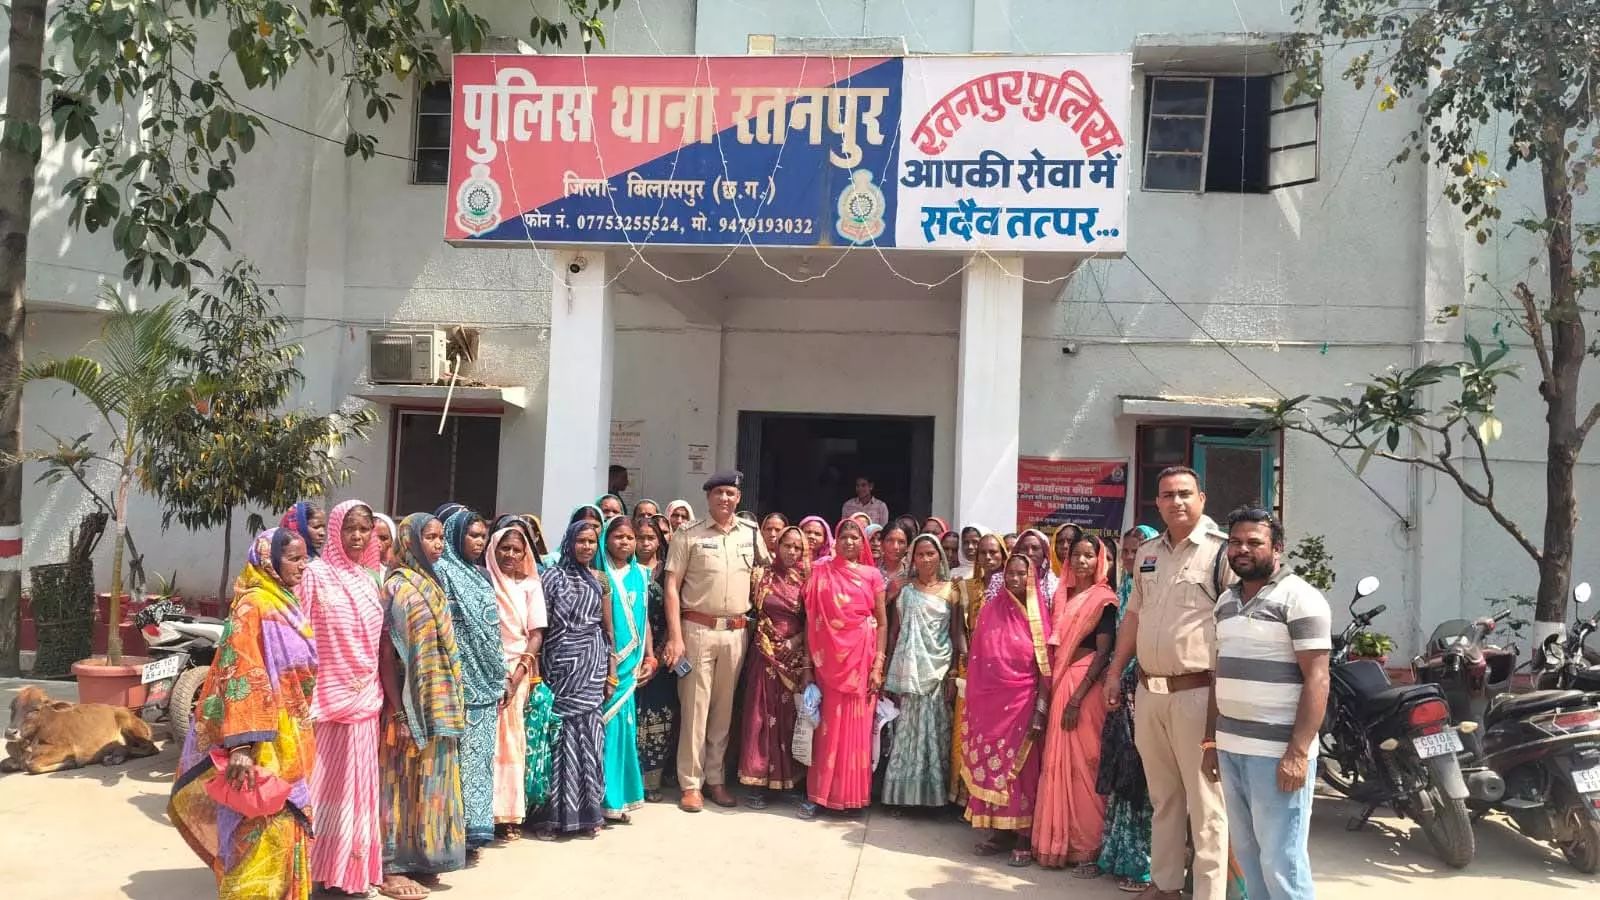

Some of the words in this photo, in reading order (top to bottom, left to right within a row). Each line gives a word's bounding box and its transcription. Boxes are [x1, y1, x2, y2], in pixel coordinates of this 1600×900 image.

[462, 68, 599, 164] पुलिस
[610, 84, 720, 145] थाना
[730, 87, 890, 170] रतनपुर
[910, 70, 1025, 156] रतनपुर
[1022, 69, 1125, 158] पुलिस
[627, 171, 706, 207] बिलासपुर
[712, 175, 776, 206] (छ.ग.)
[900, 149, 1014, 189] आपकी
[1017, 148, 1085, 193] सेवा
[1088, 150, 1122, 189] में
[524, 207, 551, 228] फोन
[691, 211, 712, 232] मो.
[719, 217, 813, 234] 9479193032
[920, 197, 1003, 244] सदैव
